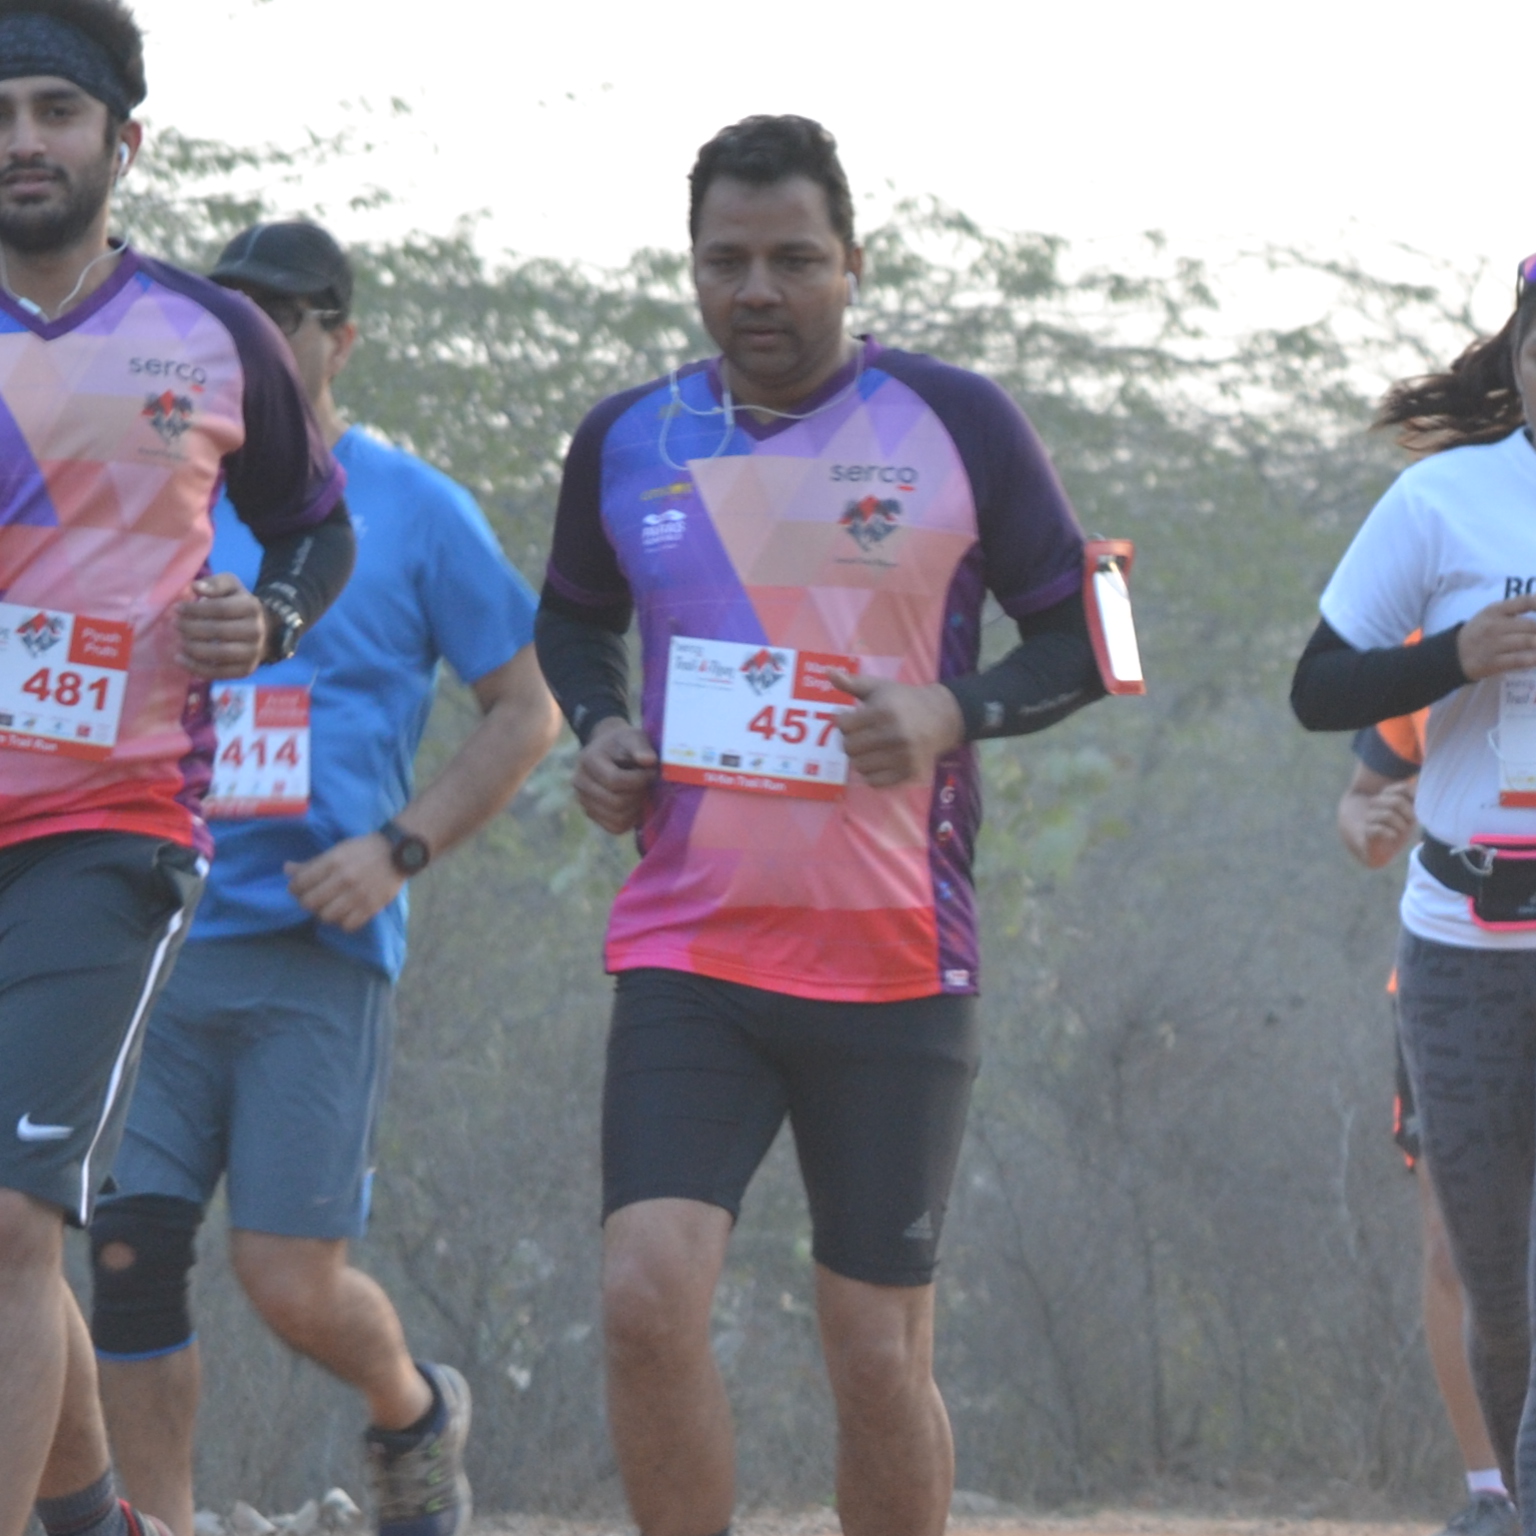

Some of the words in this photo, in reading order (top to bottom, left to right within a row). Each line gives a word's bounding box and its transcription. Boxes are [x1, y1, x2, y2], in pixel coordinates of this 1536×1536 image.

[128, 358, 206, 384] serco
[830, 465, 918, 483] serco
[22, 667, 109, 711] 481
[747, 705, 838, 747] 457
[220, 735, 300, 769] 414
